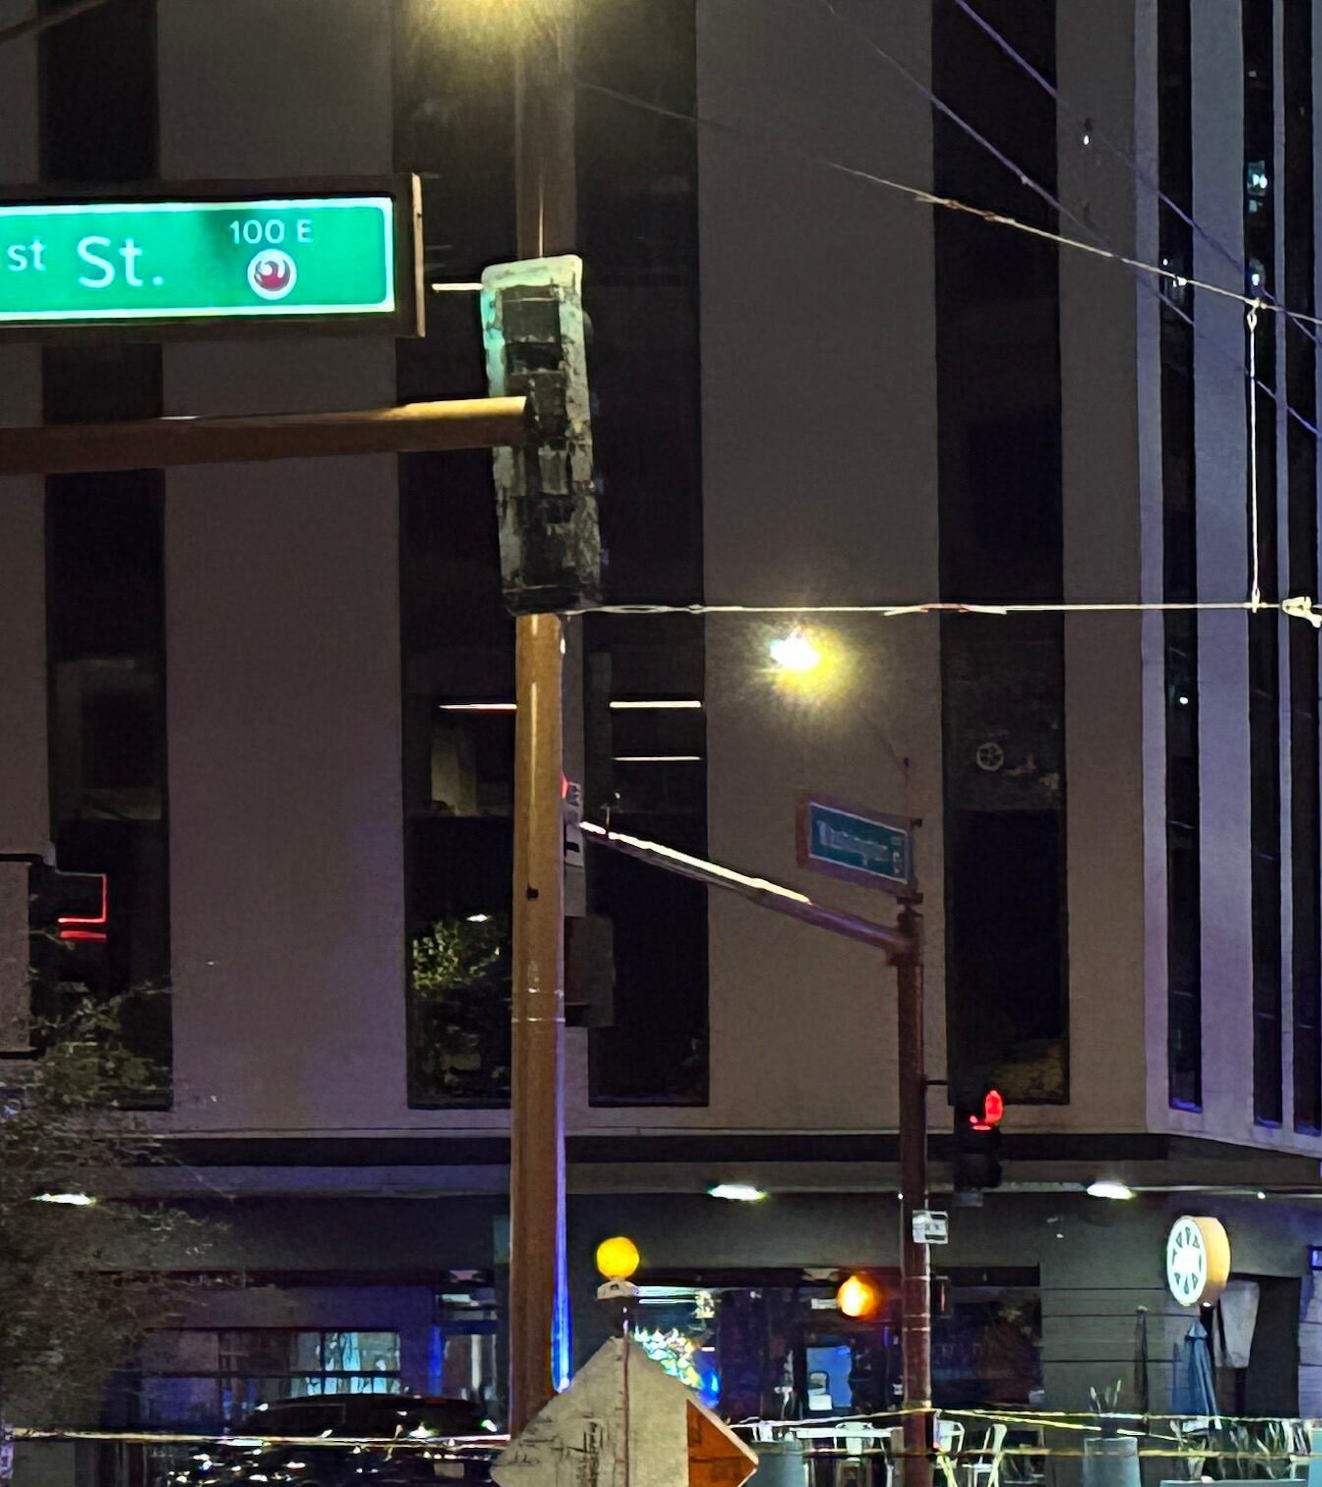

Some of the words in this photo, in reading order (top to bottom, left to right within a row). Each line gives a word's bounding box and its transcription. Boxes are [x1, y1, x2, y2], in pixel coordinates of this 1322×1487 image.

[230, 220, 285, 244] 100
[297, 220, 313, 243] E
[8, 236, 46, 271] st
[77, 236, 164, 288] St.
